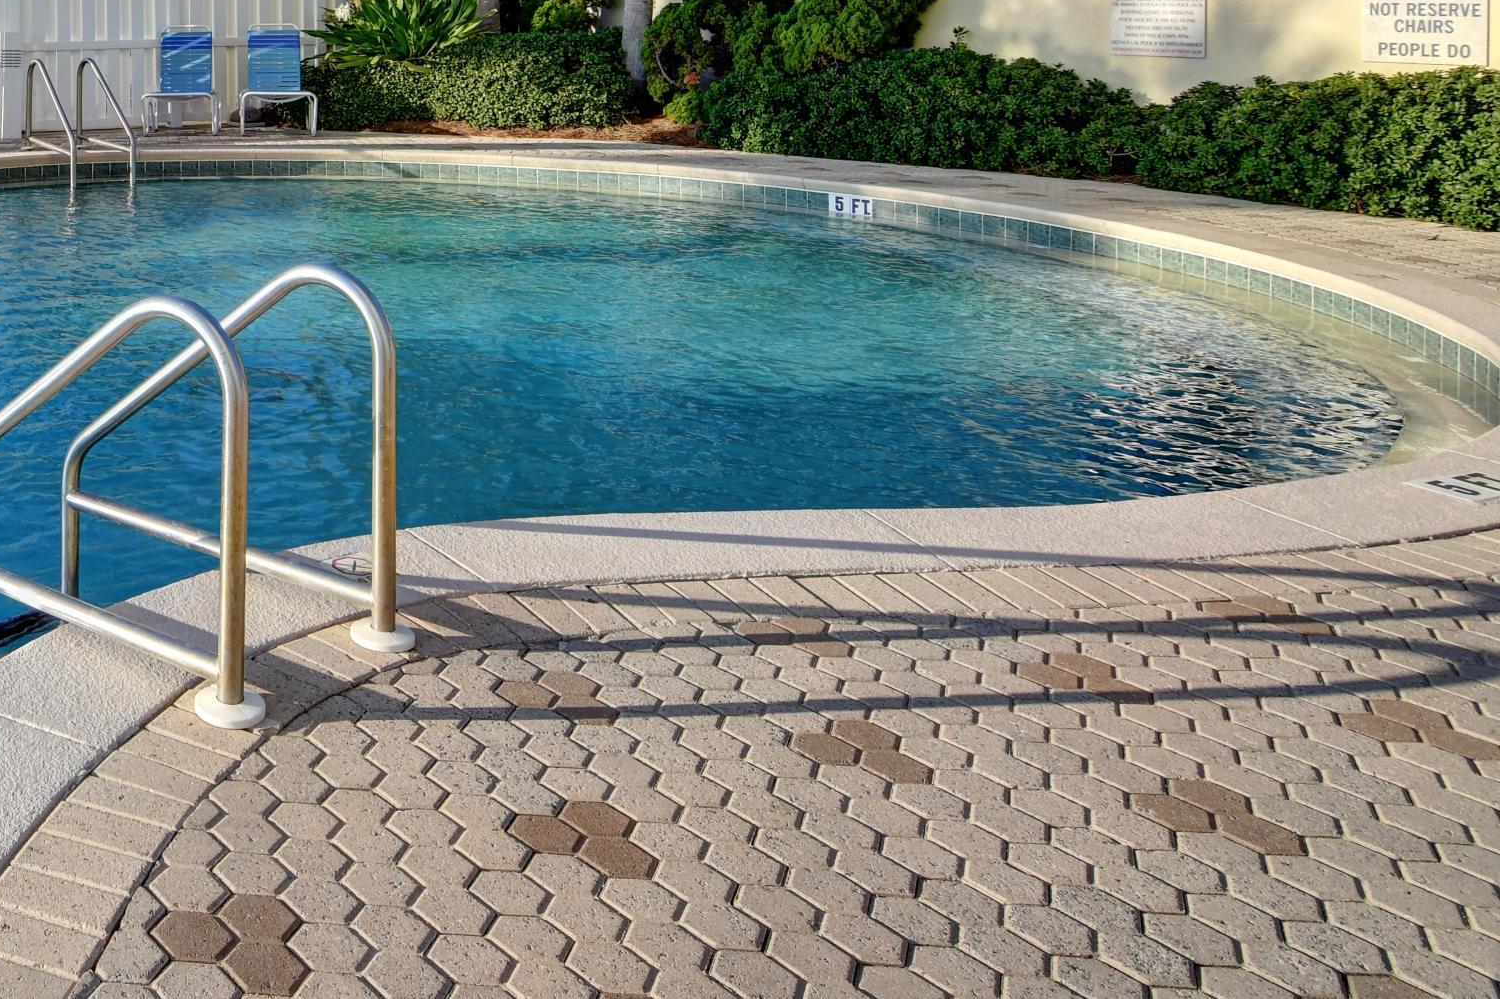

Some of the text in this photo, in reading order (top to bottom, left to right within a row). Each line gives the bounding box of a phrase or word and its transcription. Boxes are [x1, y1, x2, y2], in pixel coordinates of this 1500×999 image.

[1369, 2, 1482, 18] NOT RESERVE
[1394, 19, 1455, 34] CHAIRS
[1378, 42, 1471, 59] PEOPLE DO
[835, 195, 844, 211] 5
[1425, 480, 1481, 496] 5
